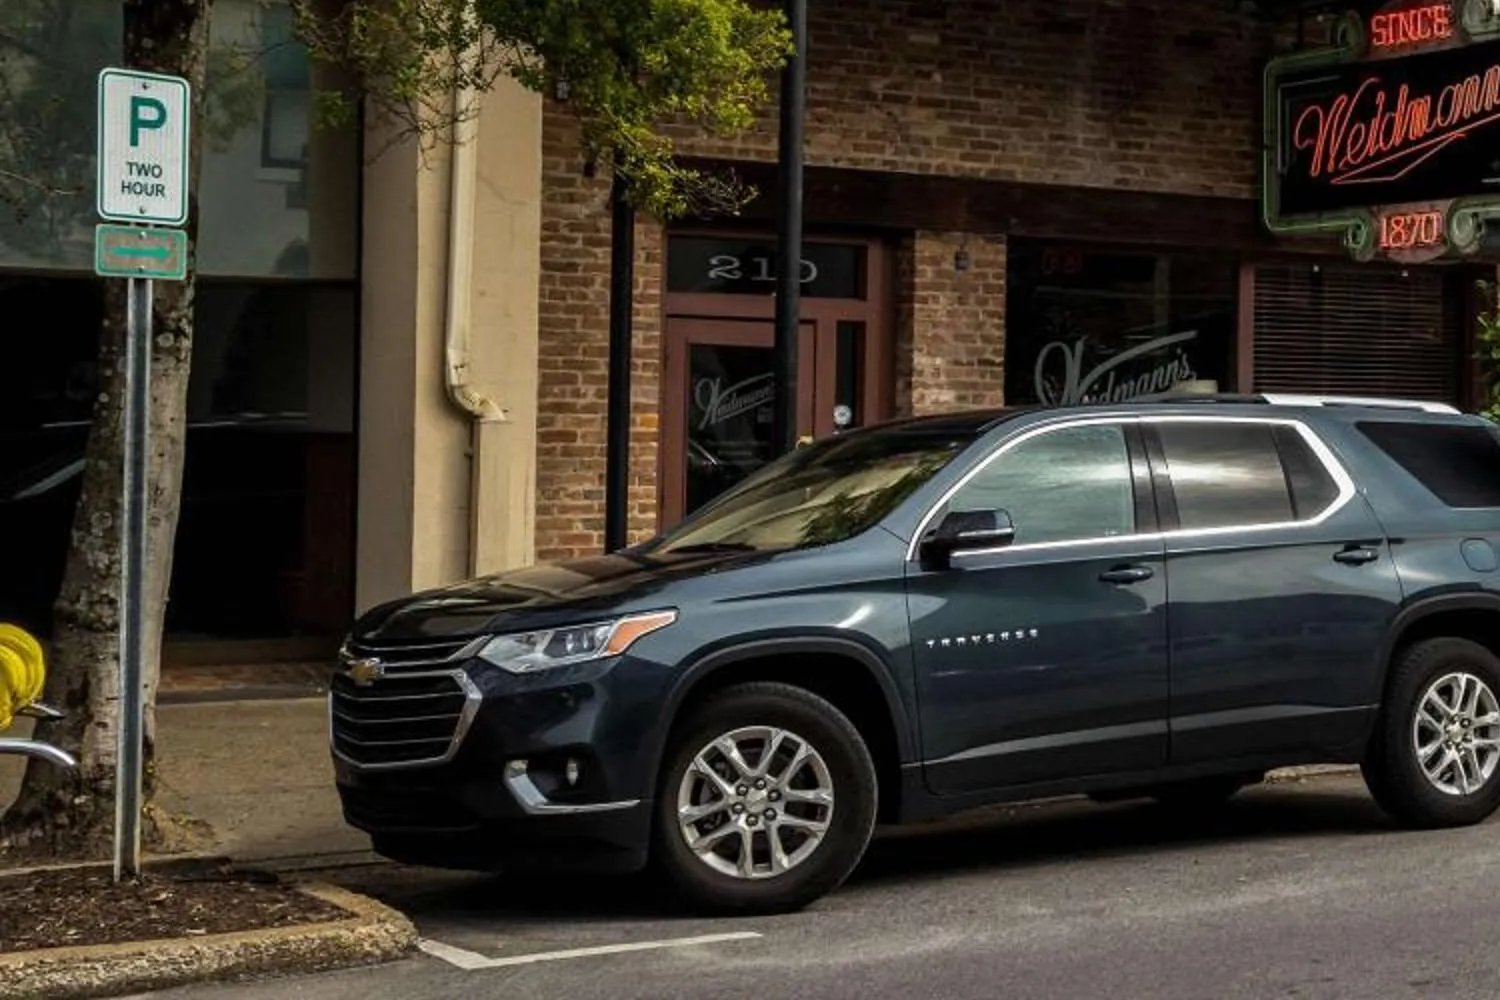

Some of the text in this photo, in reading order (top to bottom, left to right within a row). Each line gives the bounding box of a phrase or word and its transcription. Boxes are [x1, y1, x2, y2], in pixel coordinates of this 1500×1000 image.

[1371, 3, 1451, 46] SINCE
[129, 95, 167, 147] P
[126, 161, 163, 179] TWO
[121, 180, 165, 198] HOUR
[1379, 211, 1442, 249] 1870
[926, 627, 1039, 649] TRAVERSE
